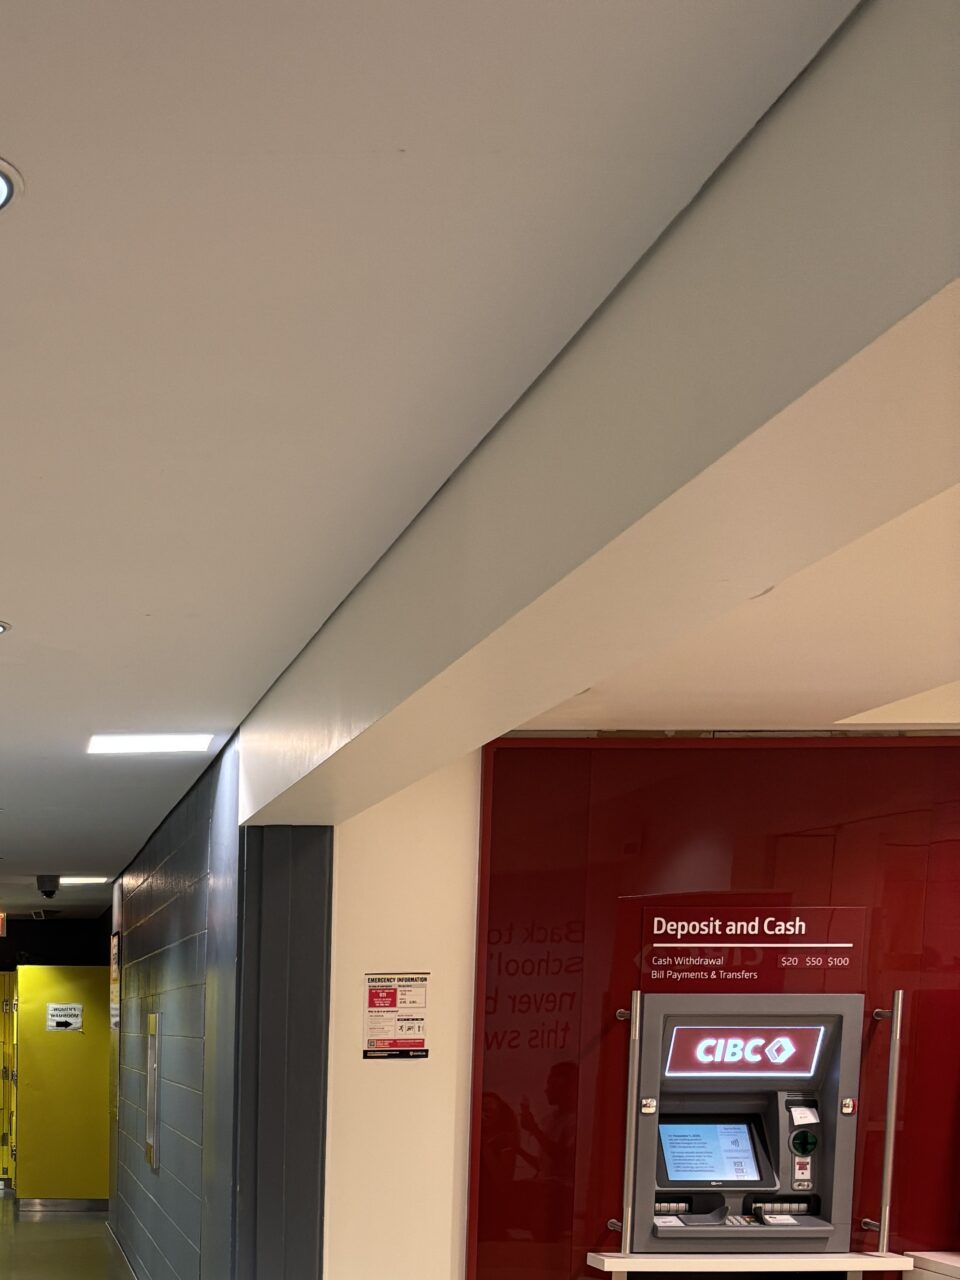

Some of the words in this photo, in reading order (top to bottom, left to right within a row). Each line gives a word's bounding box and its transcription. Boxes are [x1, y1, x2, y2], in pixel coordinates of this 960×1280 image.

[652, 917, 722, 939] Deposit
[725, 917, 759, 935] and
[763, 917, 806, 935] Cash
[651, 956, 674, 966] Cash
[674, 956, 724, 966] Withdrawal
[780, 956, 799, 967] $20
[805, 956, 824, 967] $50
[827, 956, 850, 967] $100
[651, 969, 665, 979] Bill
[666, 970, 709, 980] Payments
[710, 970, 718, 979] &
[718, 969, 758, 979] Transfers
[696, 1037, 766, 1063] CIBC
